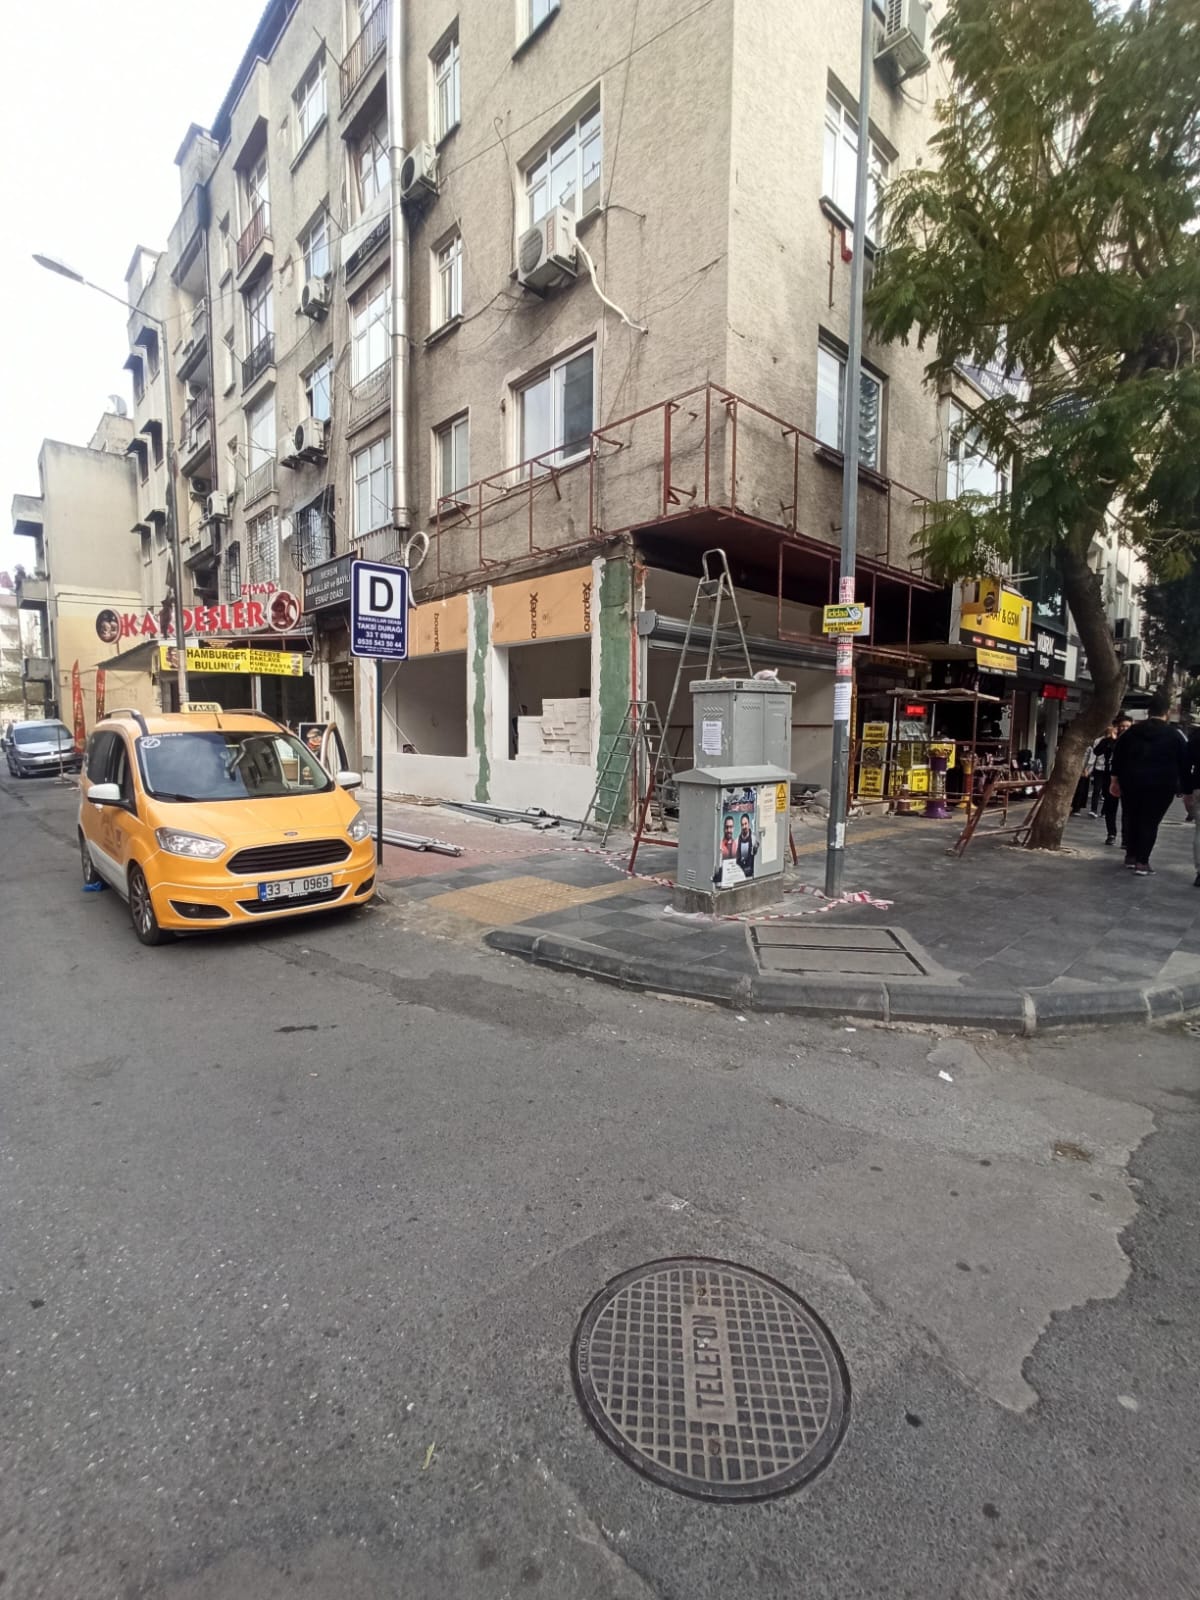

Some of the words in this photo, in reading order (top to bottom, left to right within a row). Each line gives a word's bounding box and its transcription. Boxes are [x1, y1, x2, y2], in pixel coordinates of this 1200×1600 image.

[369, 575, 394, 612] D
[121, 601, 265, 637] KADEŞLER
[186, 649, 248, 661] HAMBURGER
[194, 661, 241, 671] BULUNUR
[267, 883, 281, 896] 33
[289, 881, 296, 893] T
[303, 876, 329, 891] 0969
[691, 1314, 725, 1409] TELEFON
